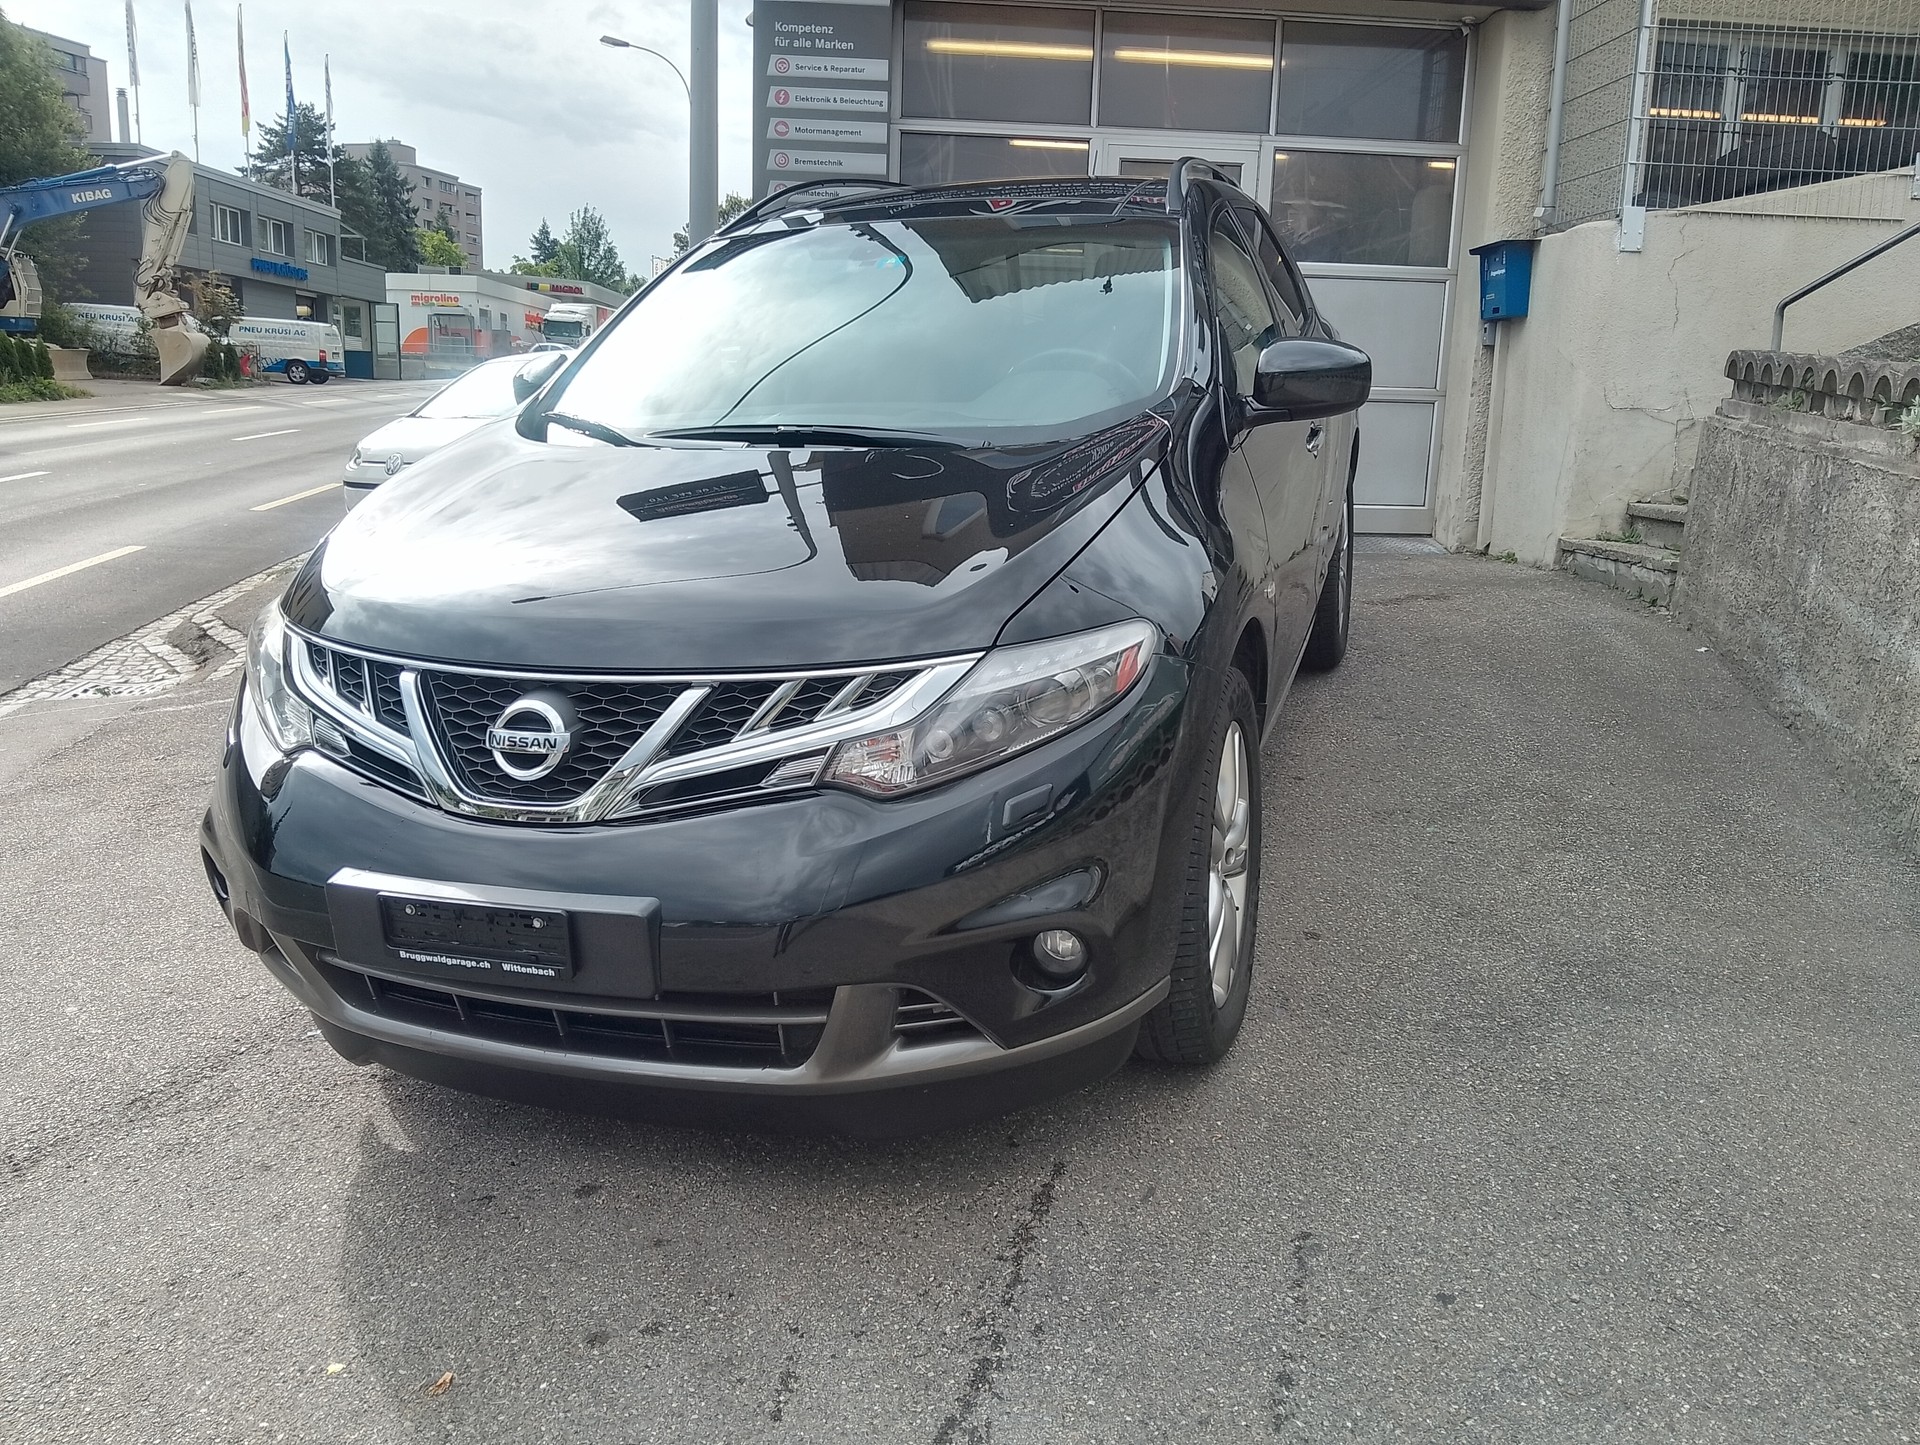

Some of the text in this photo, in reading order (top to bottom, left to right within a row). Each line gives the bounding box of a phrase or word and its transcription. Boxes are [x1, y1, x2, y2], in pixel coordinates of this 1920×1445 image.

[775, 21, 834, 35] Kompetenz
[774, 36, 855, 51] für alle Marken
[795, 63, 866, 74] Service & Reparatur
[794, 95, 884, 107] Elektronik & Beleuchtung
[794, 126, 862, 137] Motormanagement
[794, 158, 844, 167] Bremstechnik
[71, 188, 112, 204] KIBAG
[551, 284, 584, 295] MIGROL
[410, 292, 460, 304] migrolino
[238, 326, 263, 334] PNEU
[293, 329, 306, 337] AG
[490, 734, 558, 750] NISSAN
[399, 951, 555, 977] Bruggwaldgarage.ch Wittenbach
